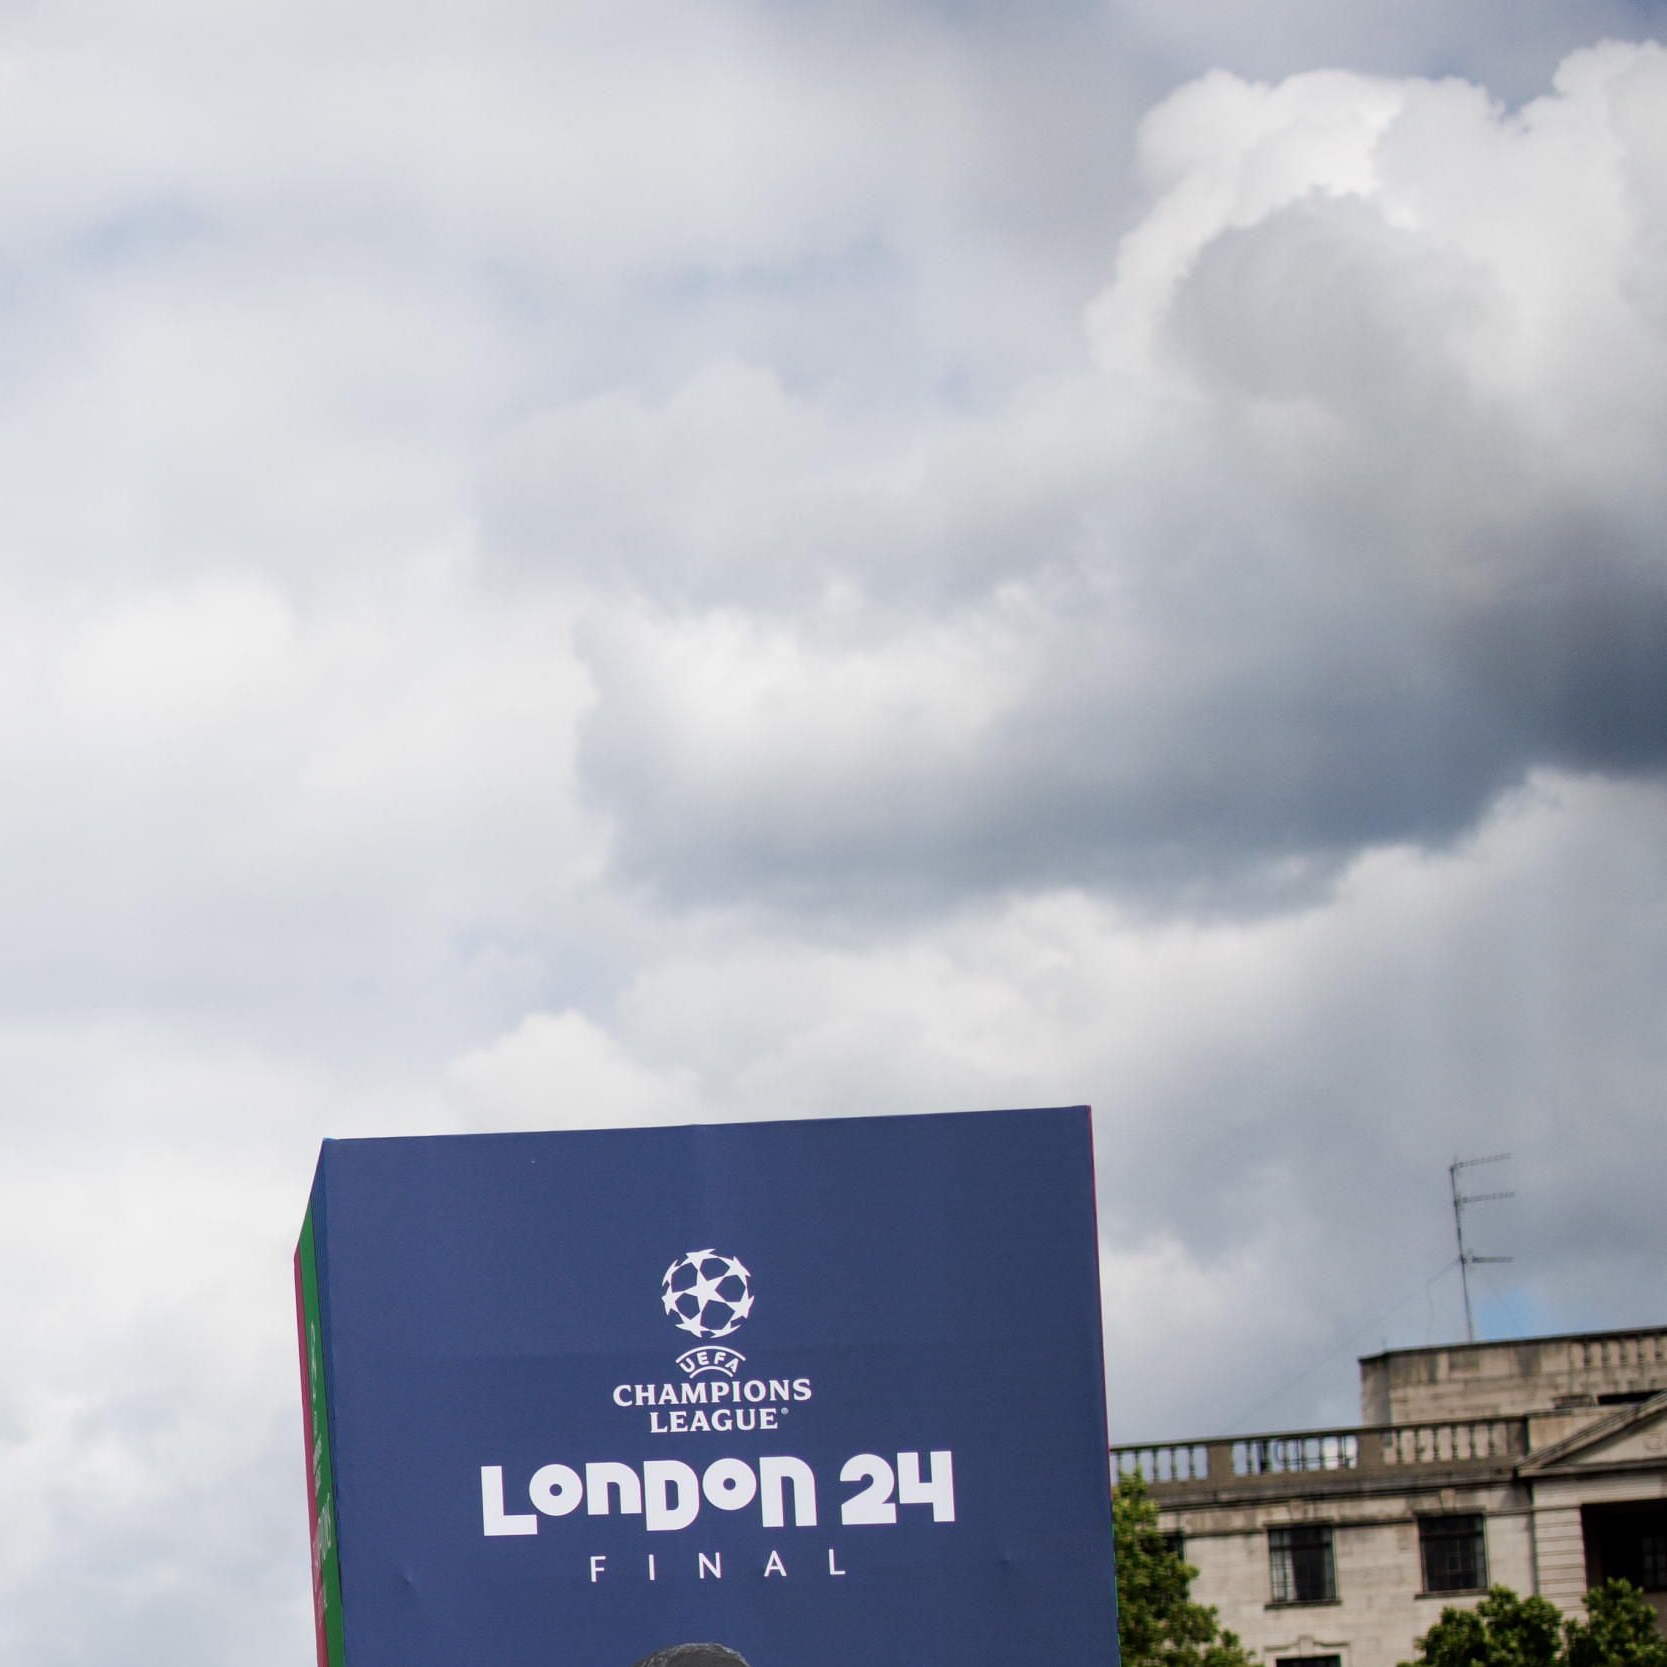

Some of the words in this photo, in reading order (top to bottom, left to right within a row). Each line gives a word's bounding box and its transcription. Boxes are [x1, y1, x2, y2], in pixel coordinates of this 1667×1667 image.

[679, 1351, 739, 1374] UEFA
[612, 1378, 813, 1407] CHAMPIONS
[649, 1408, 779, 1434] LEAGUE
[839, 1450, 956, 1526] 24
[589, 1548, 846, 1583] FINAL
